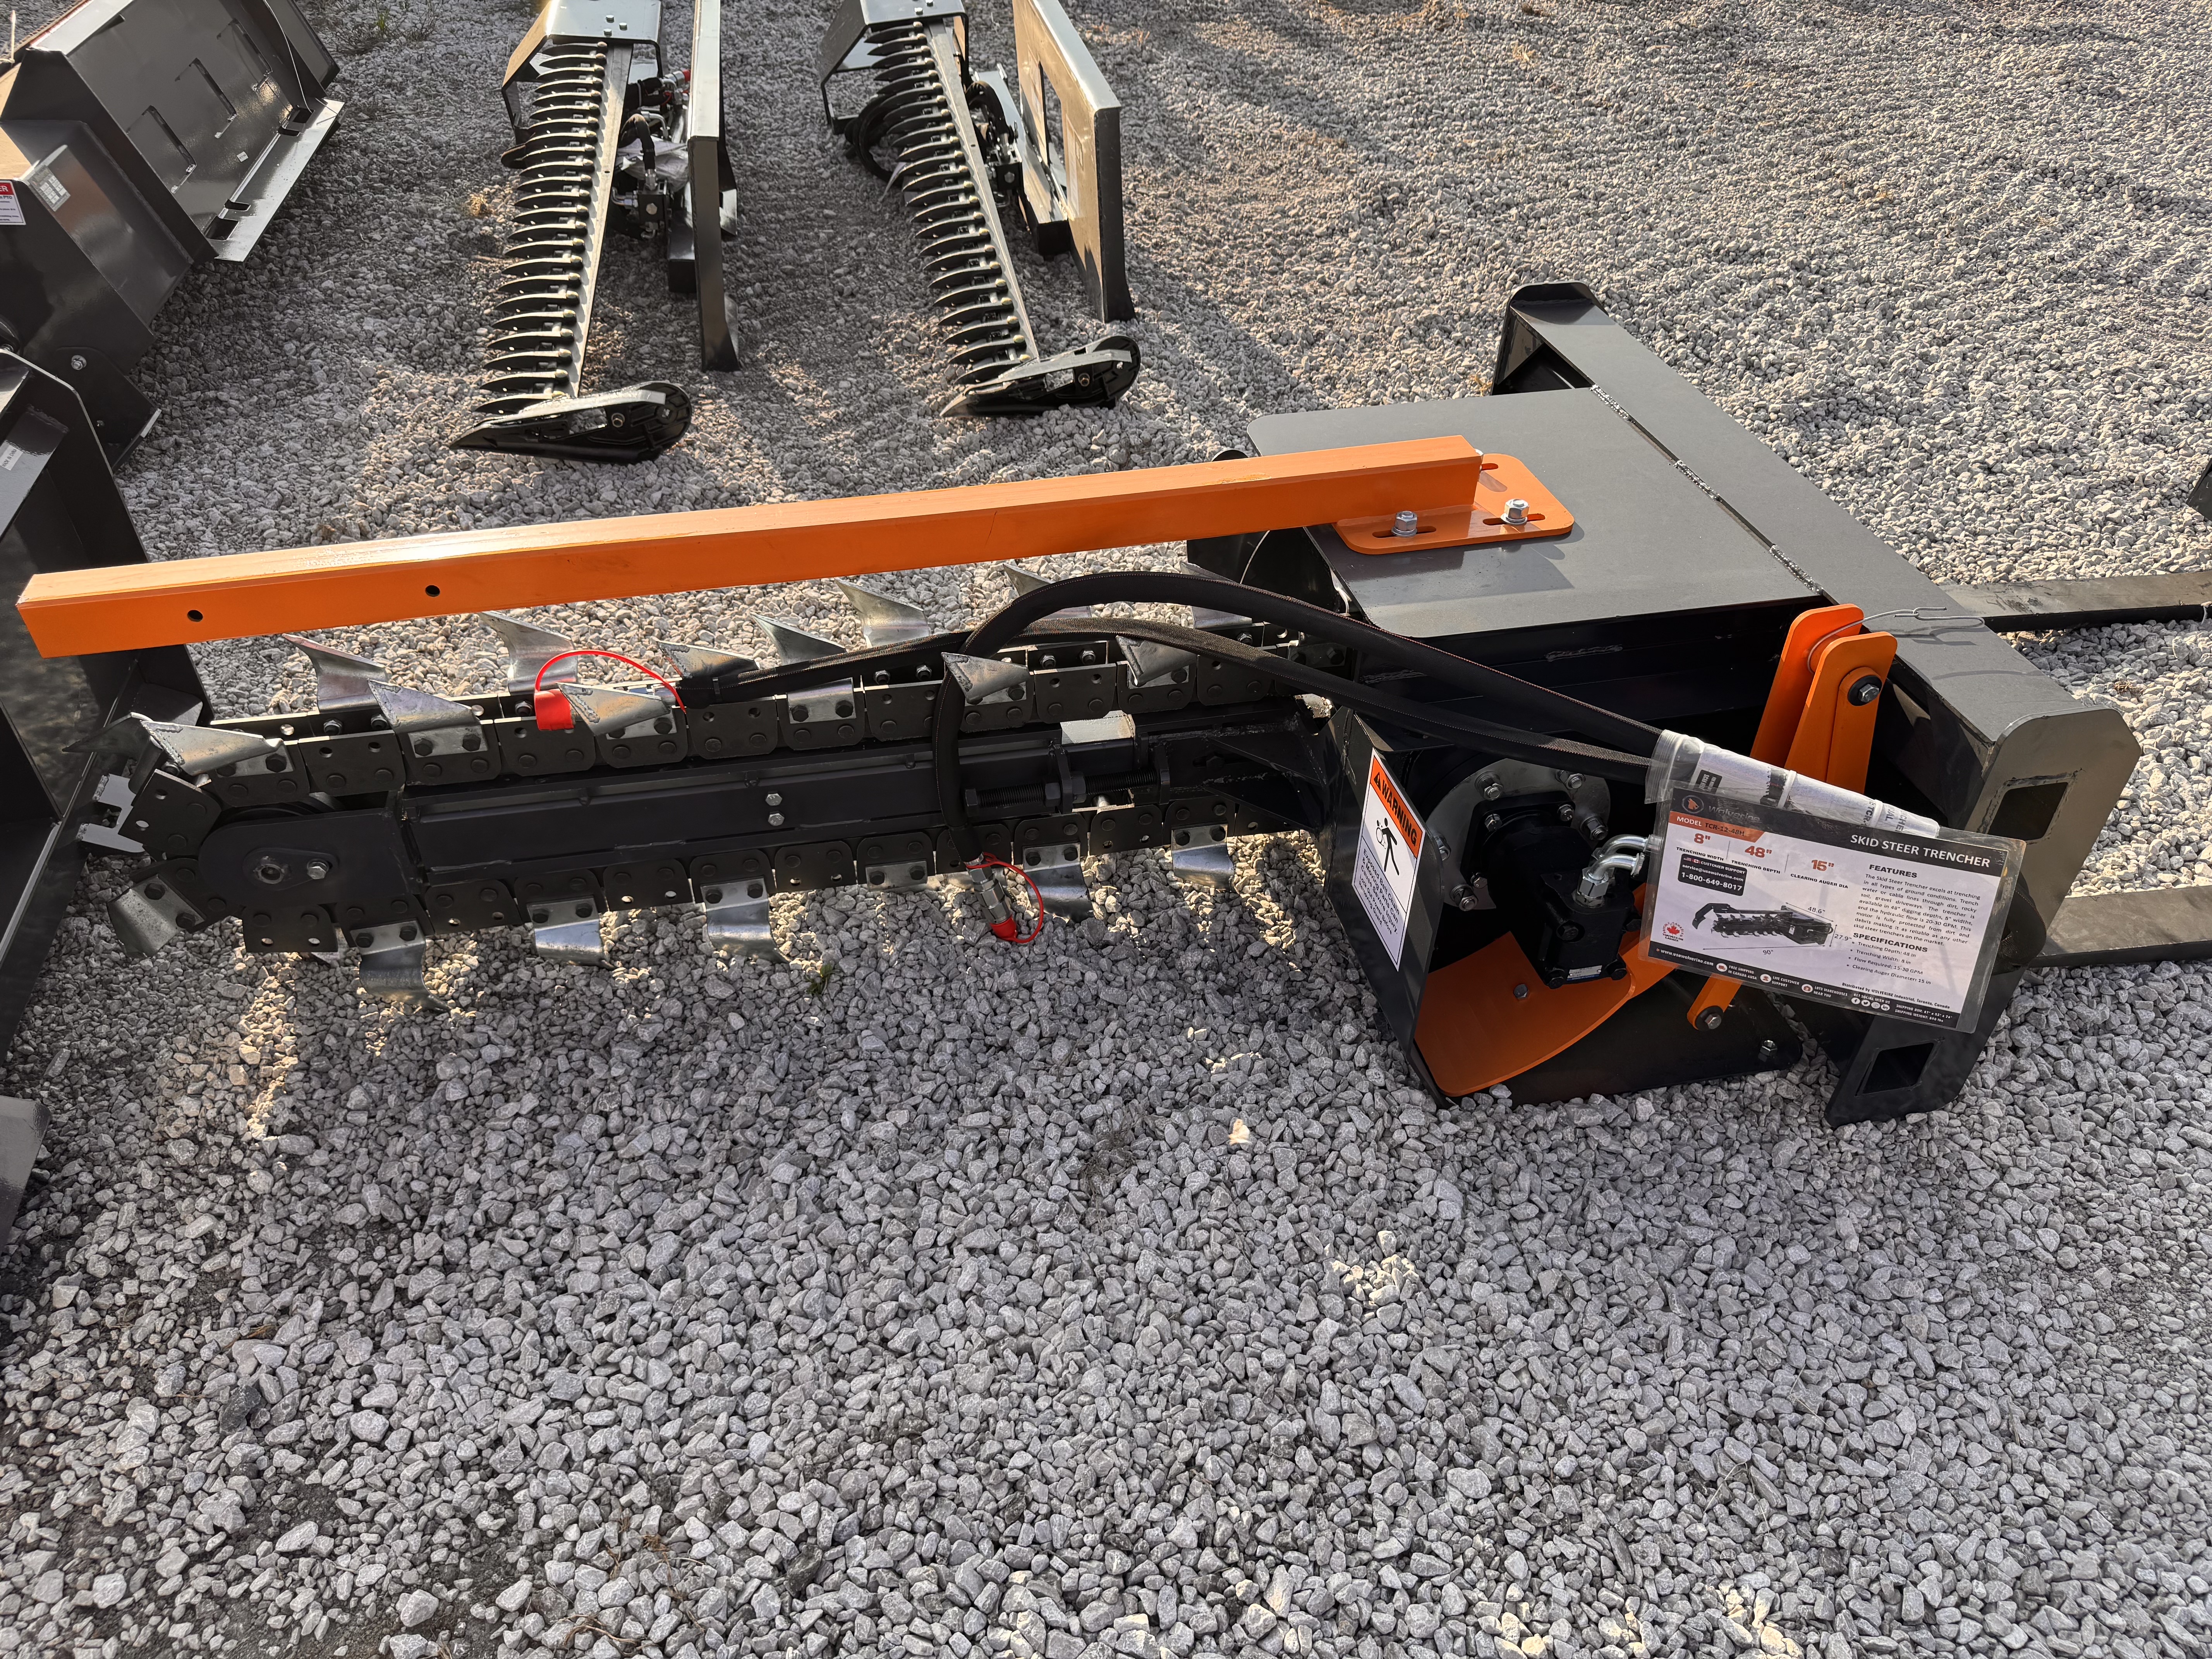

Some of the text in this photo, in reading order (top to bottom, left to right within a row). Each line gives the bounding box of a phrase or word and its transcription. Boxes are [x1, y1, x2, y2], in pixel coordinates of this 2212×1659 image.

[1382, 780, 1417, 846] WARNING
[1709, 805, 1760, 821] Wolverine
[1676, 816, 1744, 836] MODEL TCR-12-48H
[1693, 833, 1711, 844] 8"
[1676, 847, 1705, 857] TRENCHING
[1745, 845, 1772, 858] 48"
[1850, 835, 1990, 867] SKID STEER TRENCHER
[1700, 861, 1724, 869] CUSTOMER
[1731, 860, 1762, 869] TRENCHING
[1811, 859, 1834, 871] 15"
[1682, 864, 1743, 881] service@usawolverine.com
[1869, 864, 1917, 878] FEATURES
[1363, 848, 1399, 915] Exposed Belt Chain
[1681, 872, 1742, 890] 1-800-649-8017
[1790, 873, 1817, 882] CLEARING
[1362, 857, 1398, 924] & Moving Parts Can
[1954, 891, 1980, 900] trenching
[1358, 880, 1382, 927] Removing Guard.
[1361, 864, 1397, 934] Cause Severe Injury.
[1927, 893, 1956, 902] conditions.
[1895, 900, 1922, 908] driveways.
[1372, 897, 1382, 915] Power
[1382, 914, 1392, 934] Before
[1880, 910, 1904, 918] hydraulic
[1879, 929, 1904, 937] trenchers
[1853, 933, 1927, 952] SPECIFICATIONS
[1858, 941, 1883, 951] Trenching
[1661, 950, 1714, 965] www.usawolverine.com
[1856, 949, 1881, 958] Trenching
[1867, 960, 1892, 969] Required:
[1852, 964, 1873, 973] Clearing
[1891, 972, 1917, 981] Diameter:
[1824, 988, 1848, 996] WAREHOUSES
[1842, 982, 1864, 990] Distributed
